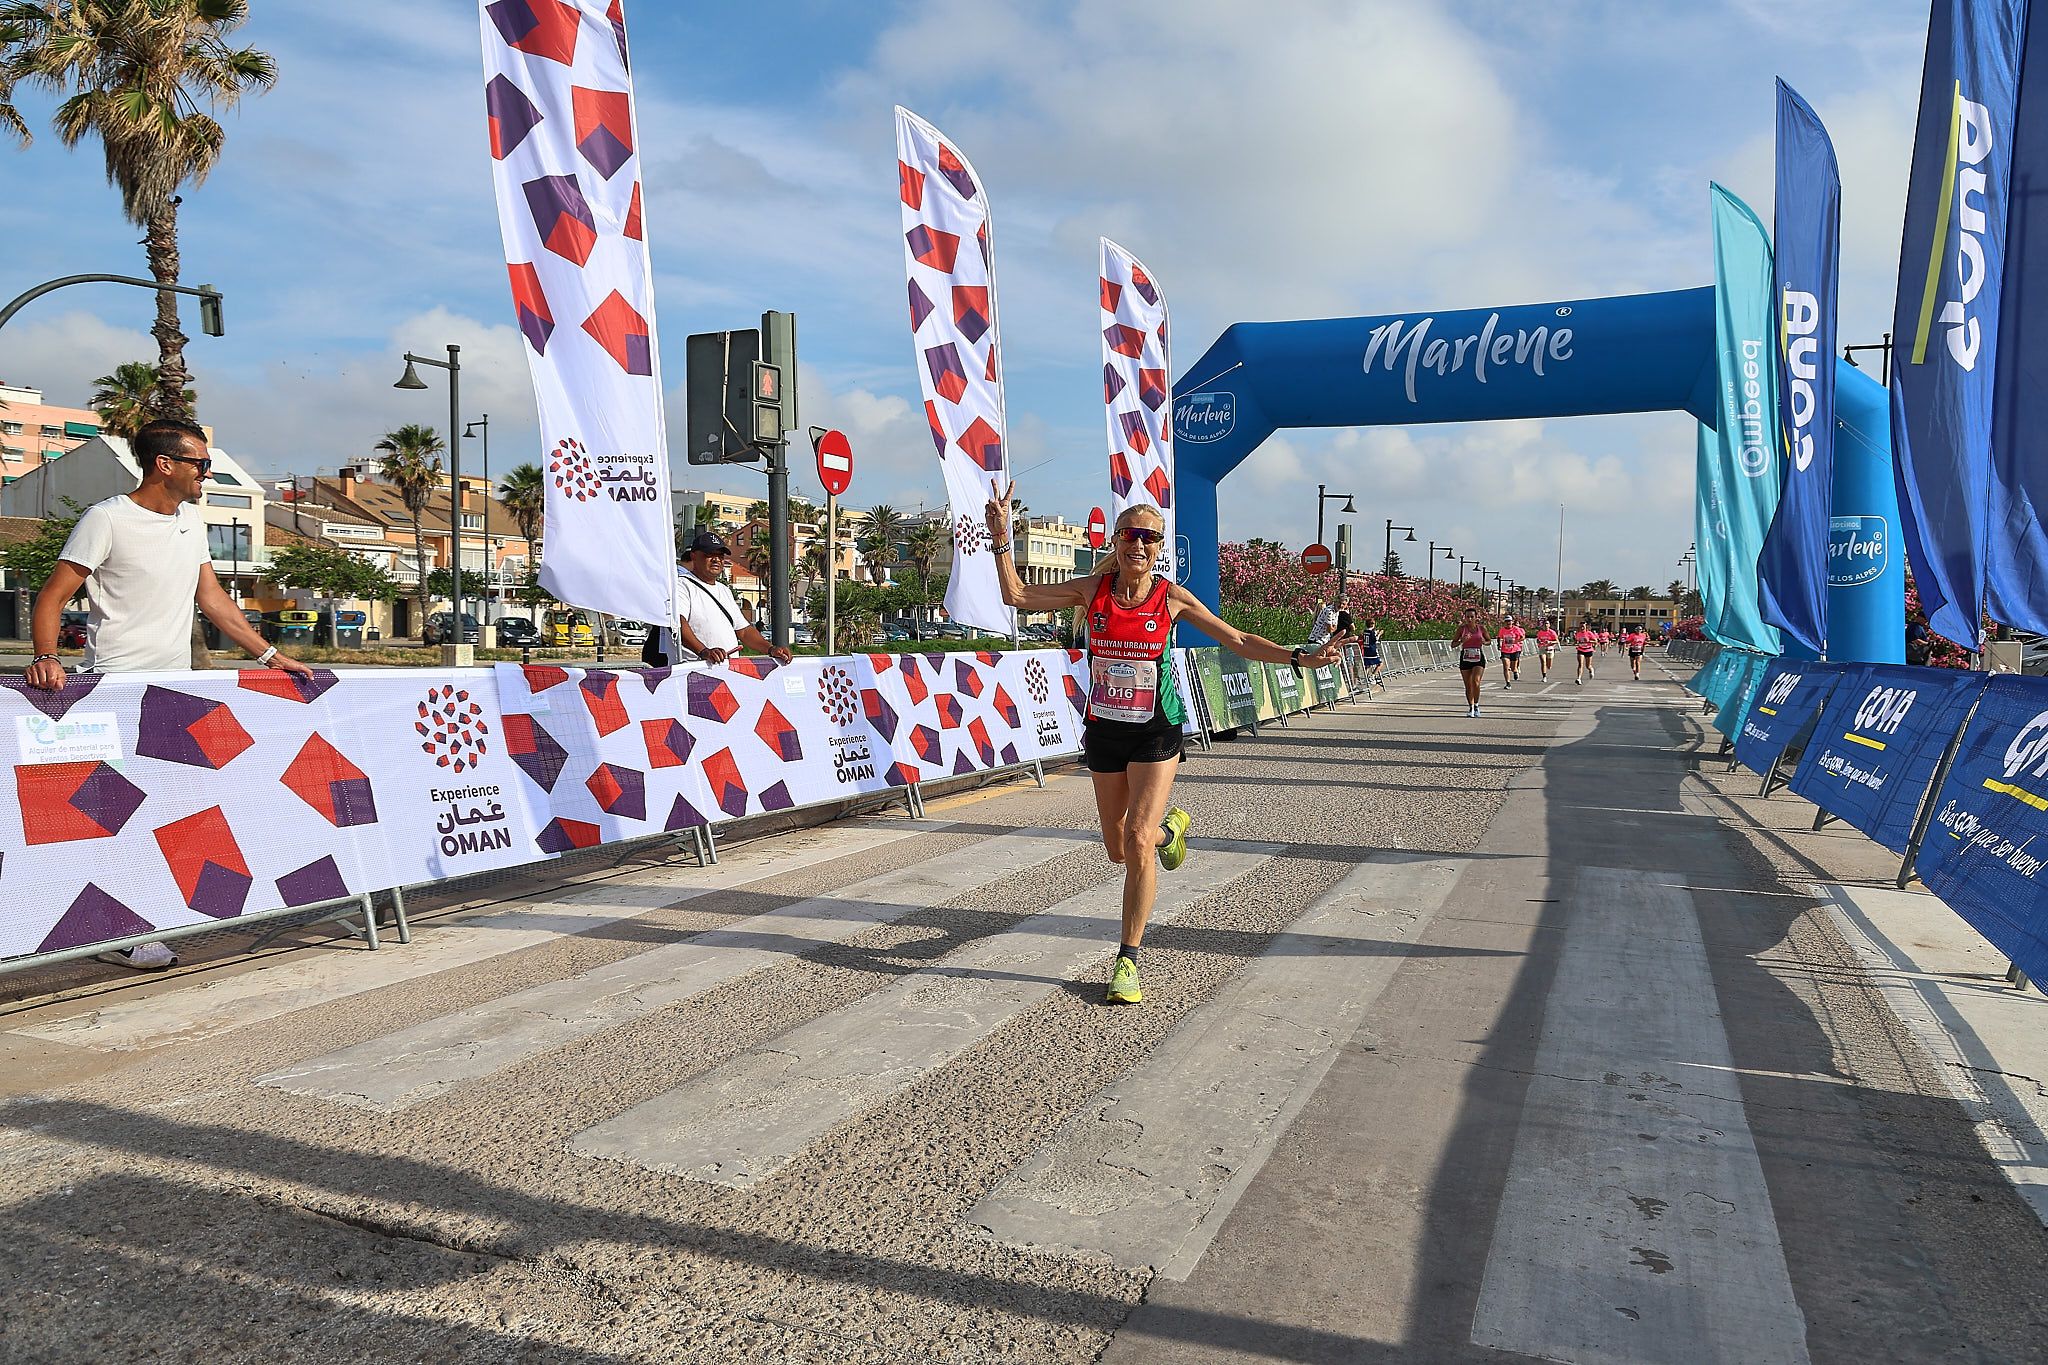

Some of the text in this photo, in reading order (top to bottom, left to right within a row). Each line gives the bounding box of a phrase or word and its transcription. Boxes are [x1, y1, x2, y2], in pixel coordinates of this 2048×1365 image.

[1363, 312, 1573, 403] Marlene
[1175, 404, 1231, 429] Marlene
[1209, 429, 1226, 440] ALPES
[1829, 531, 1883, 561] arlene
[1855, 566, 1877, 580] ALPES
[1098, 639, 1123, 648] KENYAN
[1124, 641, 1149, 650] URBAN
[1149, 642, 1163, 650] WAY
[1107, 687, 1134, 699] 016
[1764, 672, 1802, 705] GOYA
[1854, 685, 1917, 735] GOYA
[828, 734, 867, 747] Experience
[1039, 733, 1062, 747] OMAN
[29, 747, 56, 755] Alquiler
[69, 744, 98, 752] material
[99, 744, 115, 752] para
[70, 753, 108, 761] Deportivos
[836, 764, 875, 784] OMAN
[430, 785, 500, 803] Experience
[441, 827, 512, 857] OMAN
[1960, 828, 2000, 856] que
[1990, 839, 2015, 859] ser
[2006, 835, 2048, 879] bueno!
